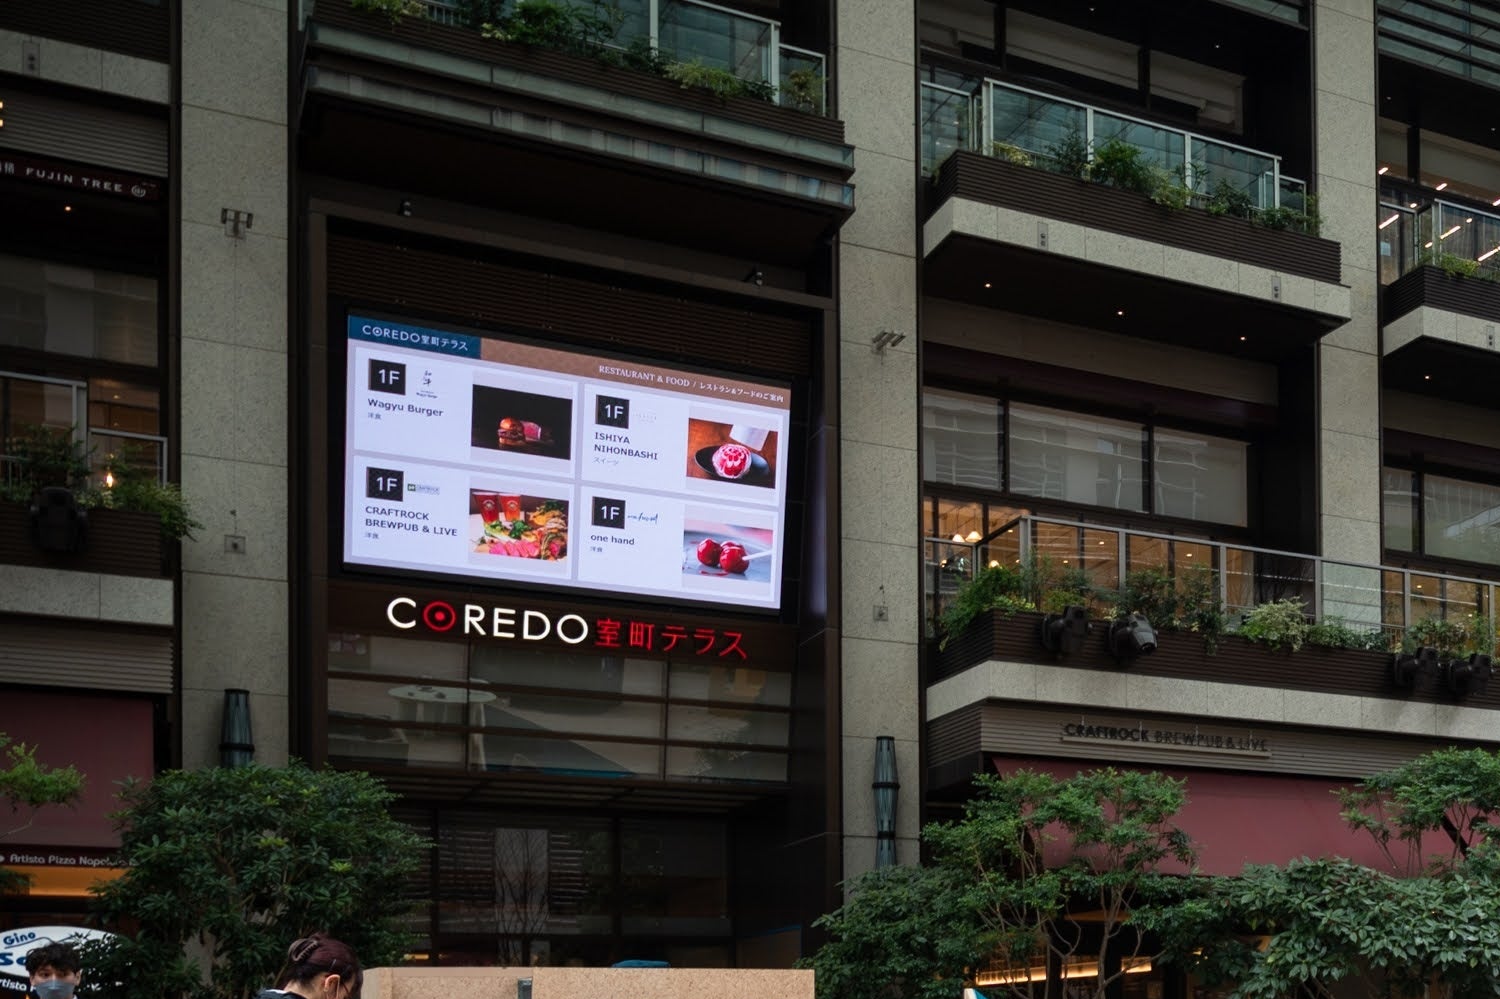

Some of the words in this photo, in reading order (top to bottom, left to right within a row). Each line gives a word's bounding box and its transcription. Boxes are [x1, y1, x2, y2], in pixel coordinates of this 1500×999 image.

[26, 167, 73, 184] FUJIN
[81, 177, 122, 192] TREE
[378, 369, 400, 386] 1F
[599, 365, 655, 381] RESTAURANT
[657, 375, 664, 383] &
[665, 376, 690, 387] FOOD
[368, 398, 404, 412] Wagyu
[407, 404, 444, 417] Burger
[604, 404, 624, 419] 1F
[594, 432, 630, 444] ISHIYA
[594, 444, 658, 460] NIHONBASHI
[376, 477, 398, 492] 1F
[365, 506, 430, 520] CRAFTROCK
[601, 505, 621, 520] 1F
[365, 518, 419, 532] BREWPUB
[434, 527, 458, 536] LIVE
[590, 534, 608, 542] one
[611, 534, 635, 546] hand
[1063, 722, 1150, 743] CRAFTROCK
[1154, 730, 1222, 750] BREWPUB
[48, 855, 76, 865] Pizza
[3, 932, 36, 946] Gino
